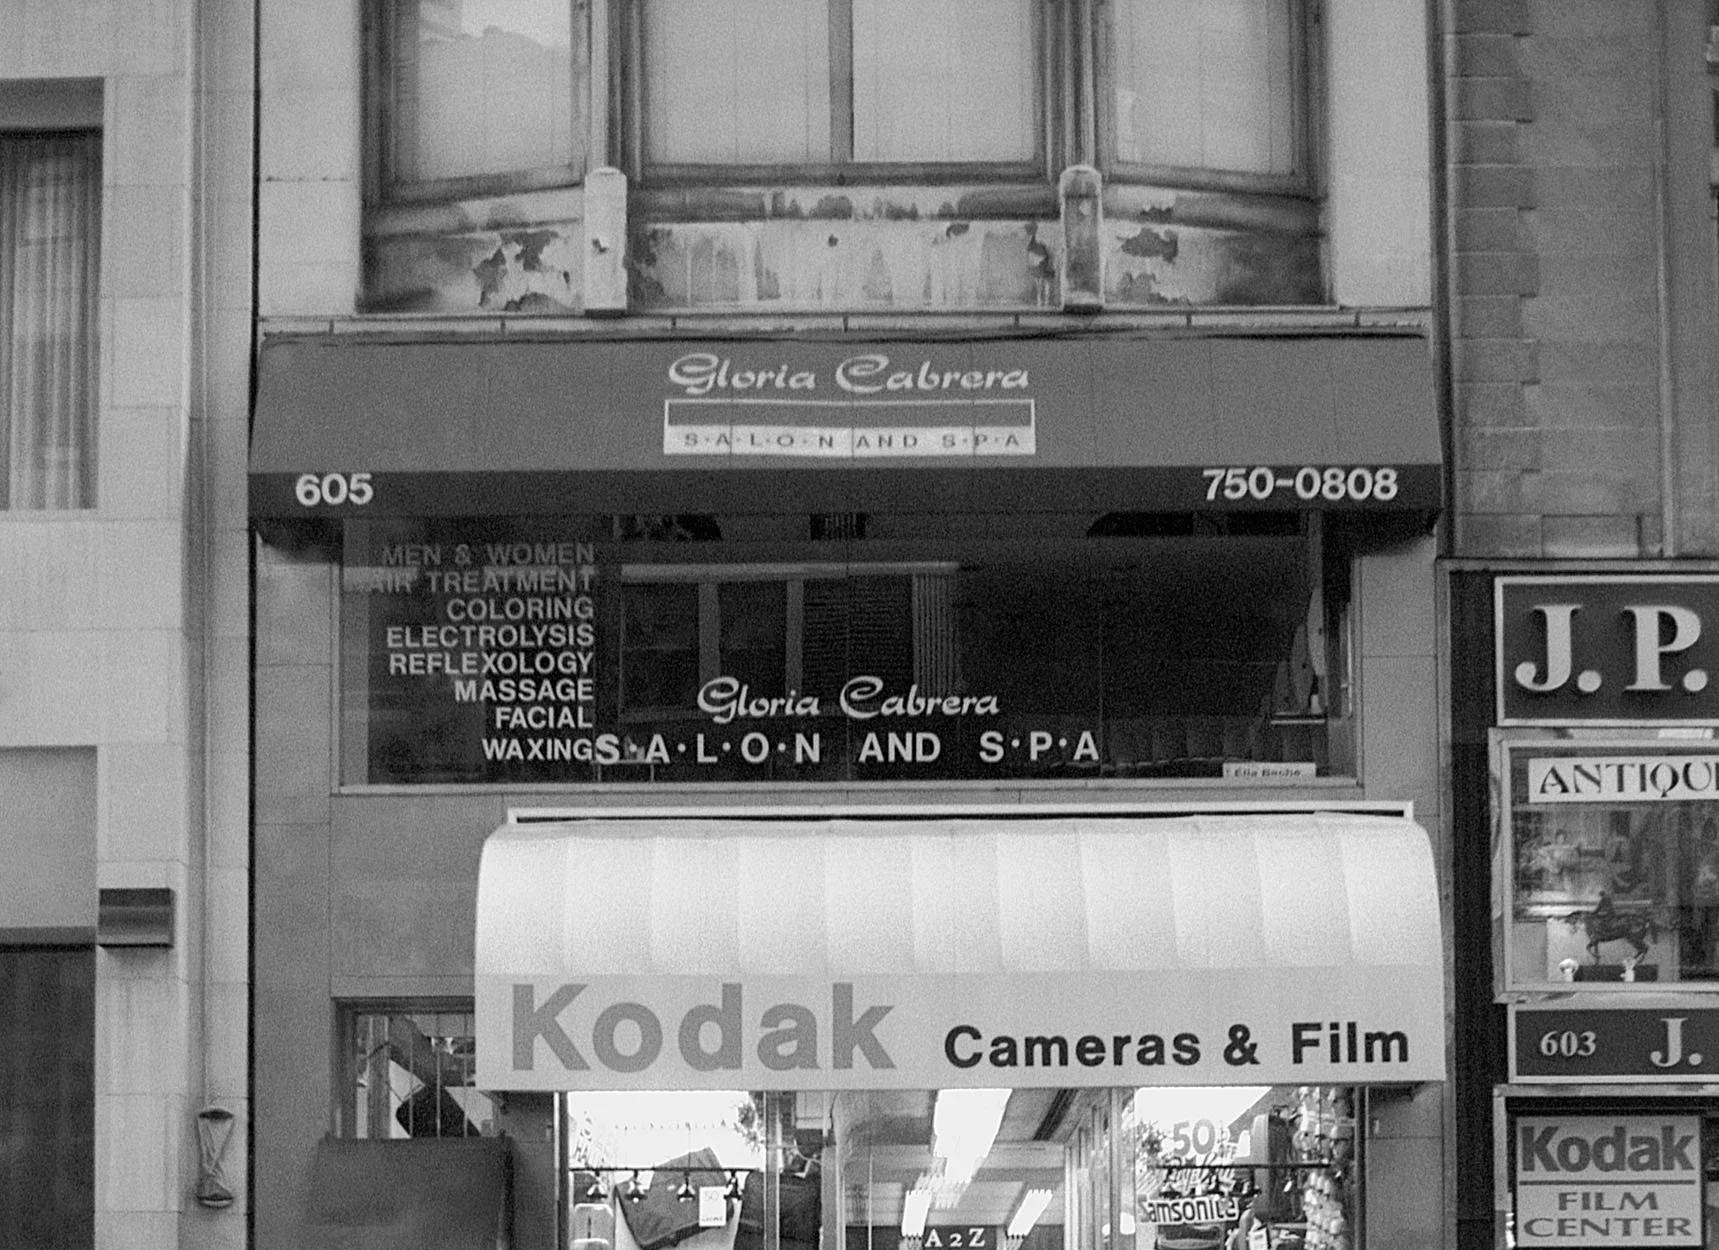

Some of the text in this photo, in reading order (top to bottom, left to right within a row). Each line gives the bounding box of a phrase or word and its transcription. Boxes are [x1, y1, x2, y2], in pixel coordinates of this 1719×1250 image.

[668, 352, 1029, 395] Gloria Cabrera
[856, 434, 918, 449] AND
[294, 472, 374, 507] 605
[1202, 466, 1399, 501] 750-0808
[384, 542, 595, 566] MEN & WOMEN
[425, 566, 595, 594] TREATMENT
[446, 596, 595, 622] COLORING
[386, 623, 595, 648] ELECTROLYSIS
[389, 651, 594, 676] REFLEXOLOGY
[454, 678, 595, 703] MASSAGE
[697, 675, 1000, 724] Gloria Cabrera
[495, 705, 594, 730] FACIAL
[482, 737, 594, 761] WAXING
[858, 731, 941, 763] AND
[1539, 761, 1719, 798] ANTIQU
[511, 982, 1410, 1073] Kodak Cameras & Film
[1540, 1017, 1703, 1068] 603 J.
[1520, 1125, 1696, 1173] Kodak
[1557, 1191, 1660, 1211] FILM
[924, 1227, 986, 1248] A 2 Z
[1523, 1217, 1693, 1238] CENTER
